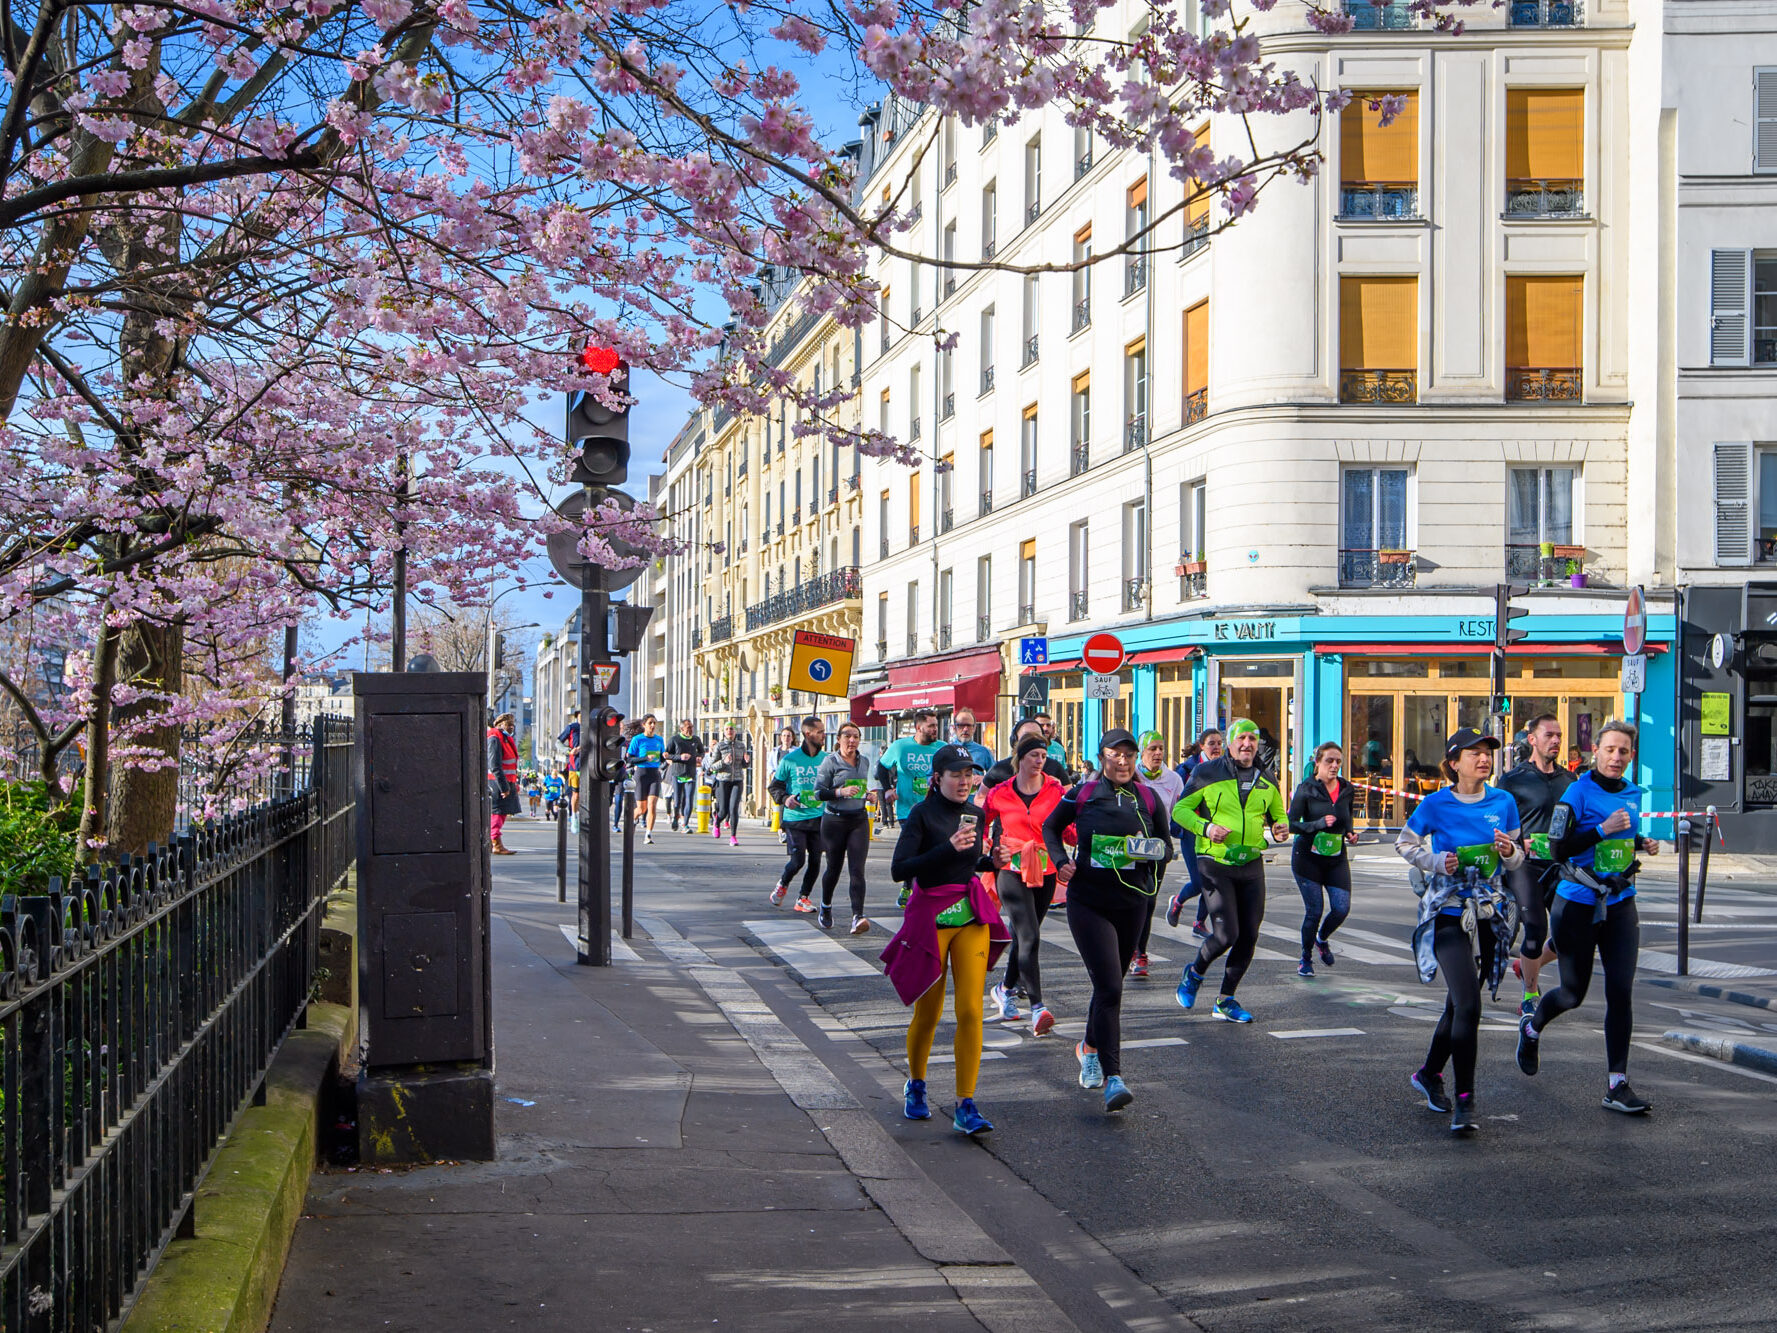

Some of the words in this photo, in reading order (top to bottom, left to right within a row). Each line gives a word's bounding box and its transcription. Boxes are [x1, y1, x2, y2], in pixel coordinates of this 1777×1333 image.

[1215, 623, 1229, 640] LE
[1233, 622, 1276, 640] VALMY
[1459, 620, 1497, 636] REST
[803, 633, 847, 648] ATTENTION
[1094, 676, 1112, 684] SAUF
[907, 752, 933, 763] RAT
[796, 765, 818, 777] RAT
[1474, 854, 1490, 865] 272
[1610, 849, 1623, 859] 271
